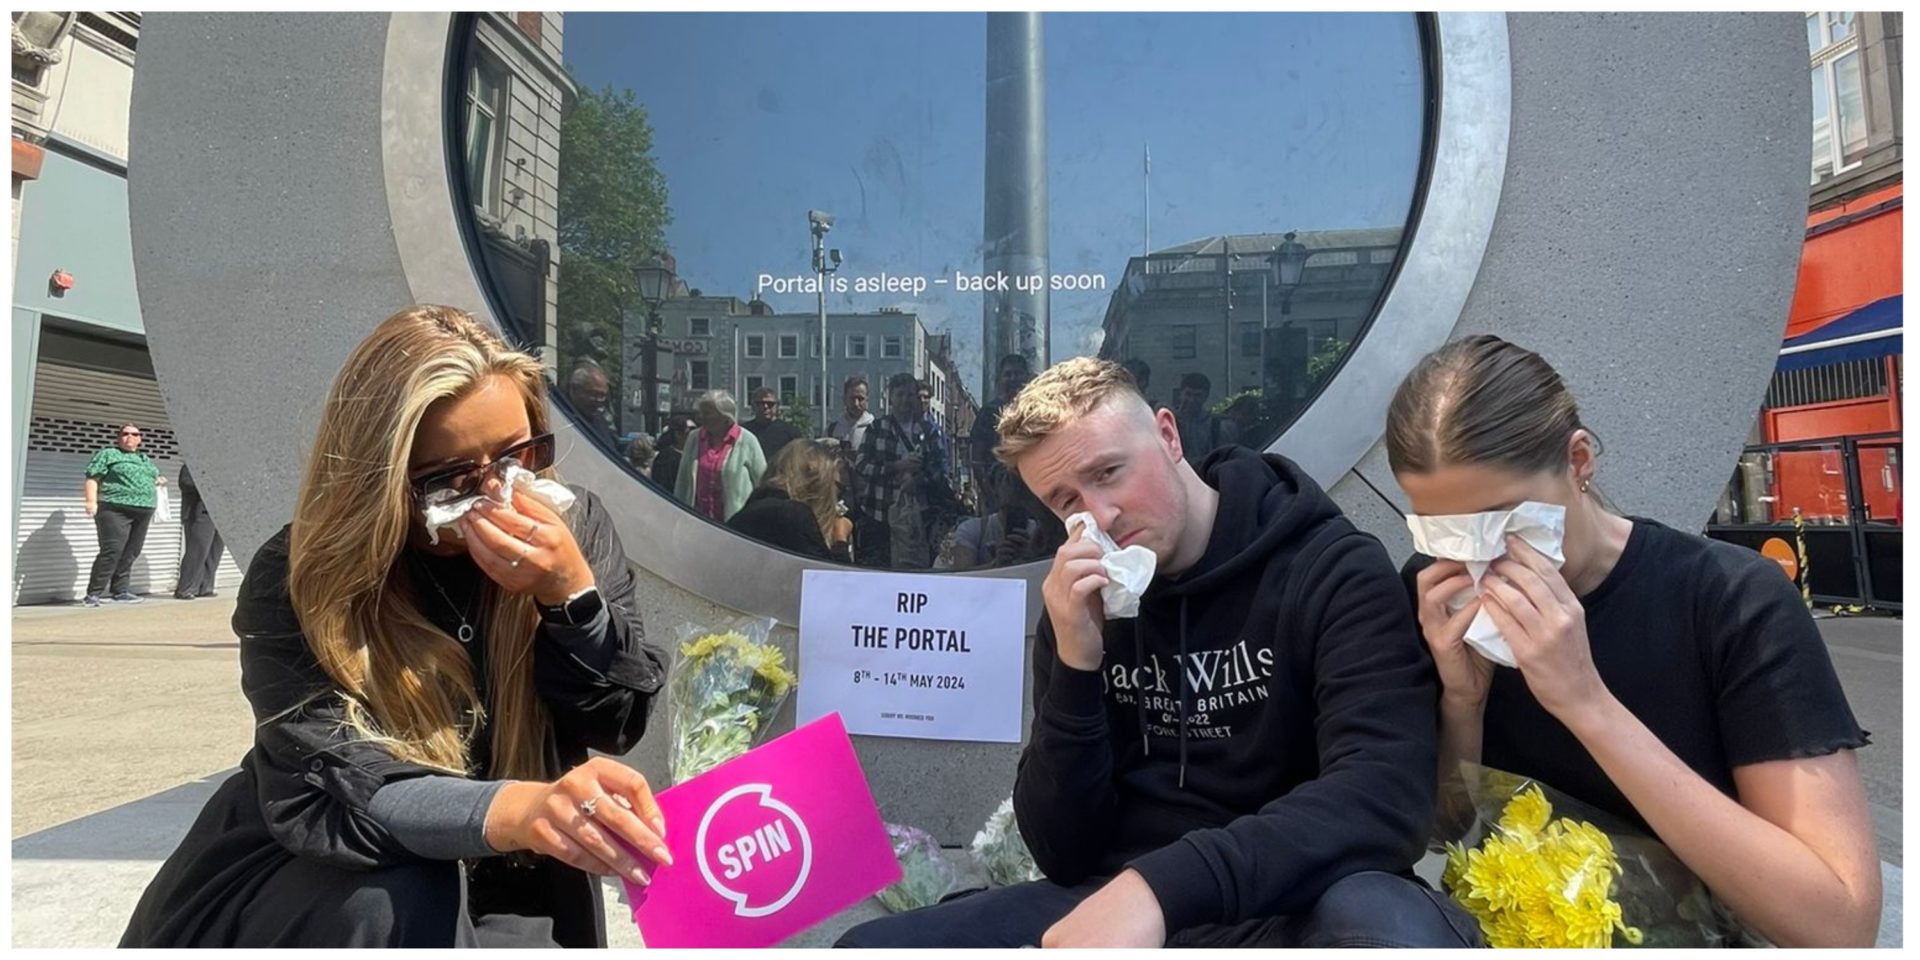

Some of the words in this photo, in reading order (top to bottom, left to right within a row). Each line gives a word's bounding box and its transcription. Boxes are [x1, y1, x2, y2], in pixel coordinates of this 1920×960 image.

[758, 273, 823, 293] Portal
[829, 273, 848, 292] is
[854, 273, 927, 296] asleep
[955, 271, 1009, 292] back
[1016, 274, 1043, 294] up
[1050, 274, 1105, 290] soon
[897, 592, 928, 614] RIP
[852, 625, 888, 648] THE
[895, 628, 971, 652] PORTAL
[854, 670, 871, 684] 8TH
[884, 672, 907, 686] 14TH
[910, 674, 933, 688] MAY
[937, 675, 965, 690] 2024
[1103, 654, 1171, 694] Jack
[1173, 640, 1273, 693] Wills
[1197, 685, 1269, 712] BRITAIN
[718, 819, 792, 880] SPIN
